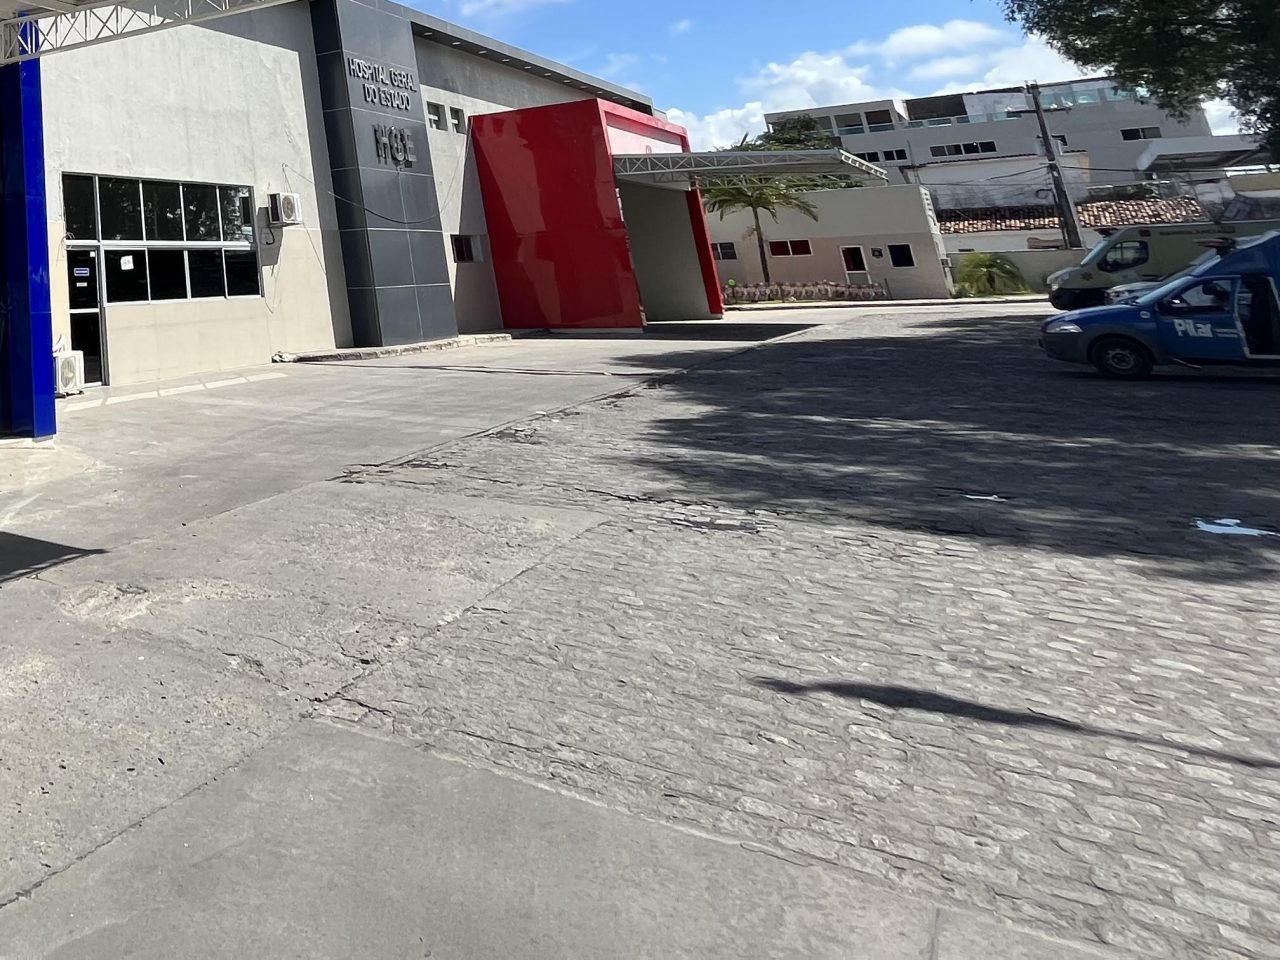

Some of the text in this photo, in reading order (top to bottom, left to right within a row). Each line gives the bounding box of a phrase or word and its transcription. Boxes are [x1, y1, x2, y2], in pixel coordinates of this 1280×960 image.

[349, 58, 417, 92] HOSPITAL GERAL
[363, 83, 411, 110] DO ESTADO
[375, 125, 417, 163] HGE
